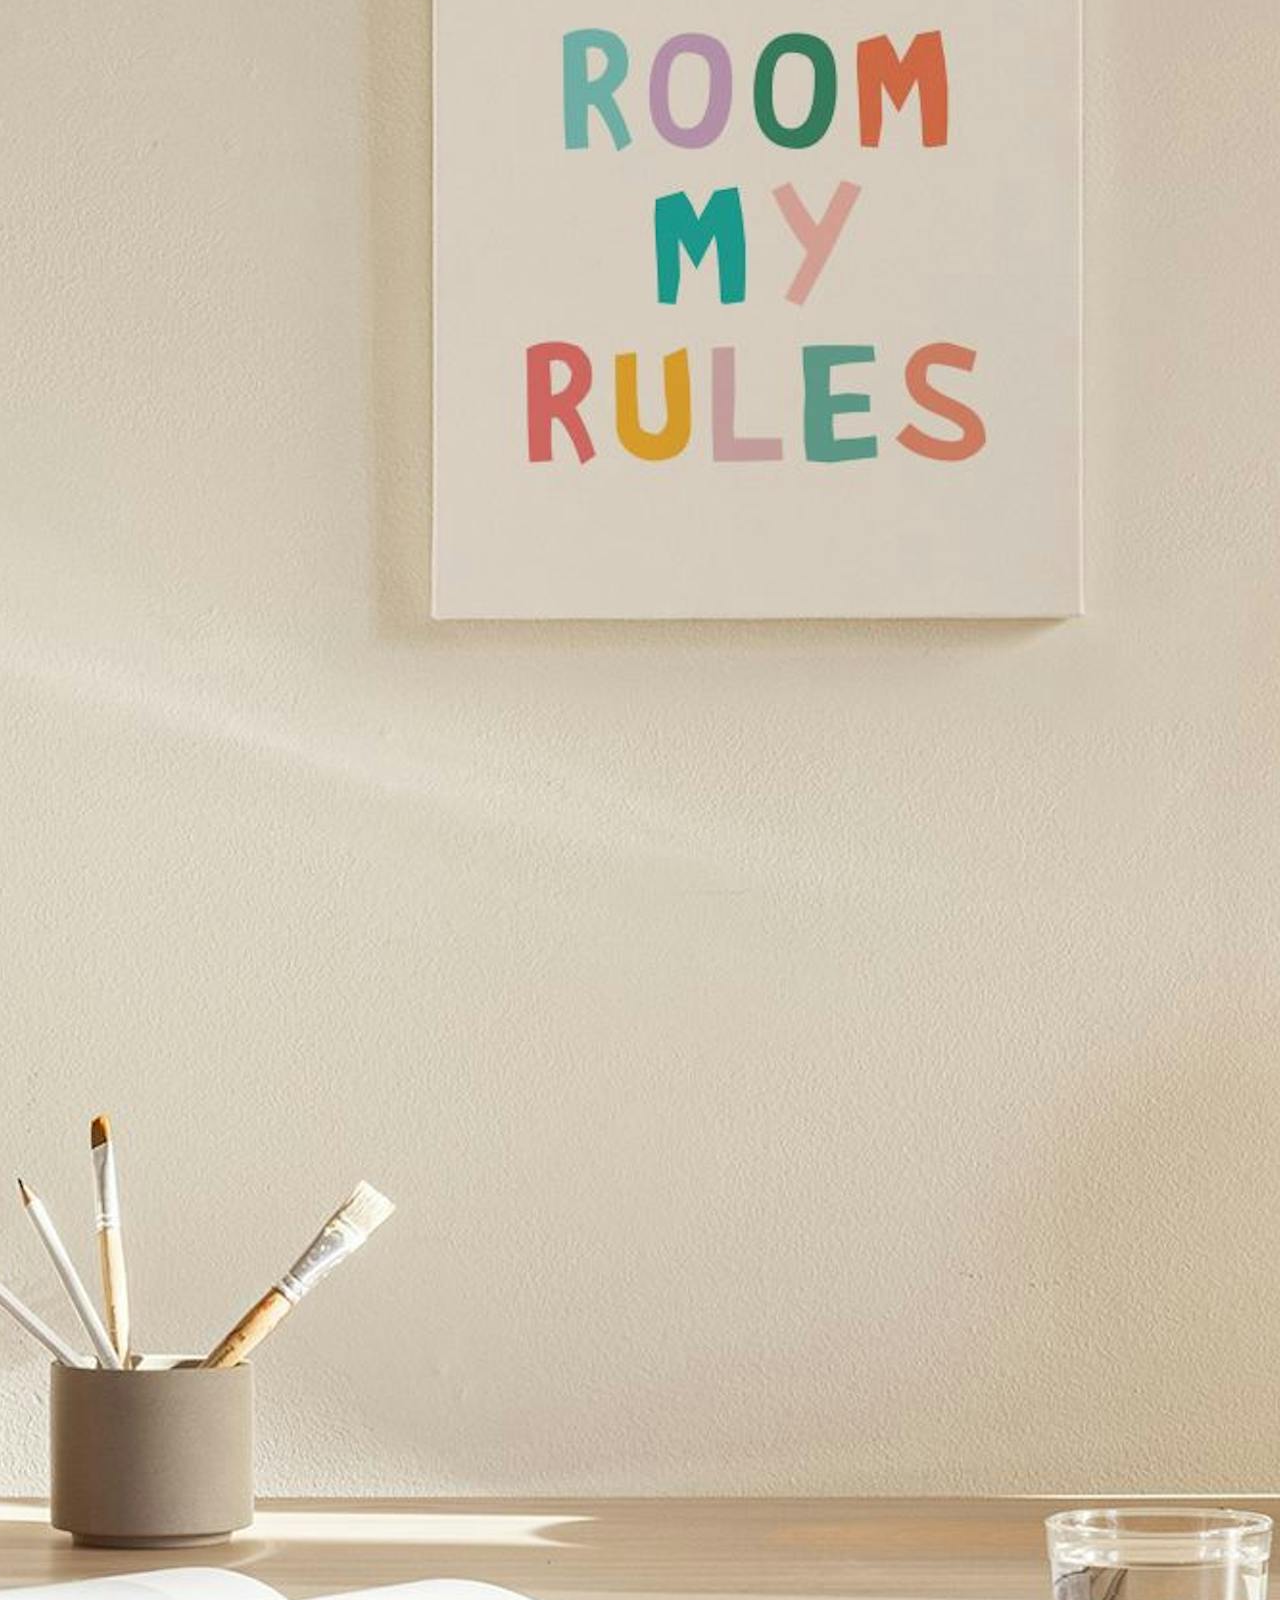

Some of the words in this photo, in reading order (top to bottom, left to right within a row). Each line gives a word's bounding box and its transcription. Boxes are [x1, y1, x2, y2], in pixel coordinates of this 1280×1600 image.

[563, 28, 949, 151] ROOM
[655, 180, 862, 306] MY
[526, 341, 987, 464] RULES
